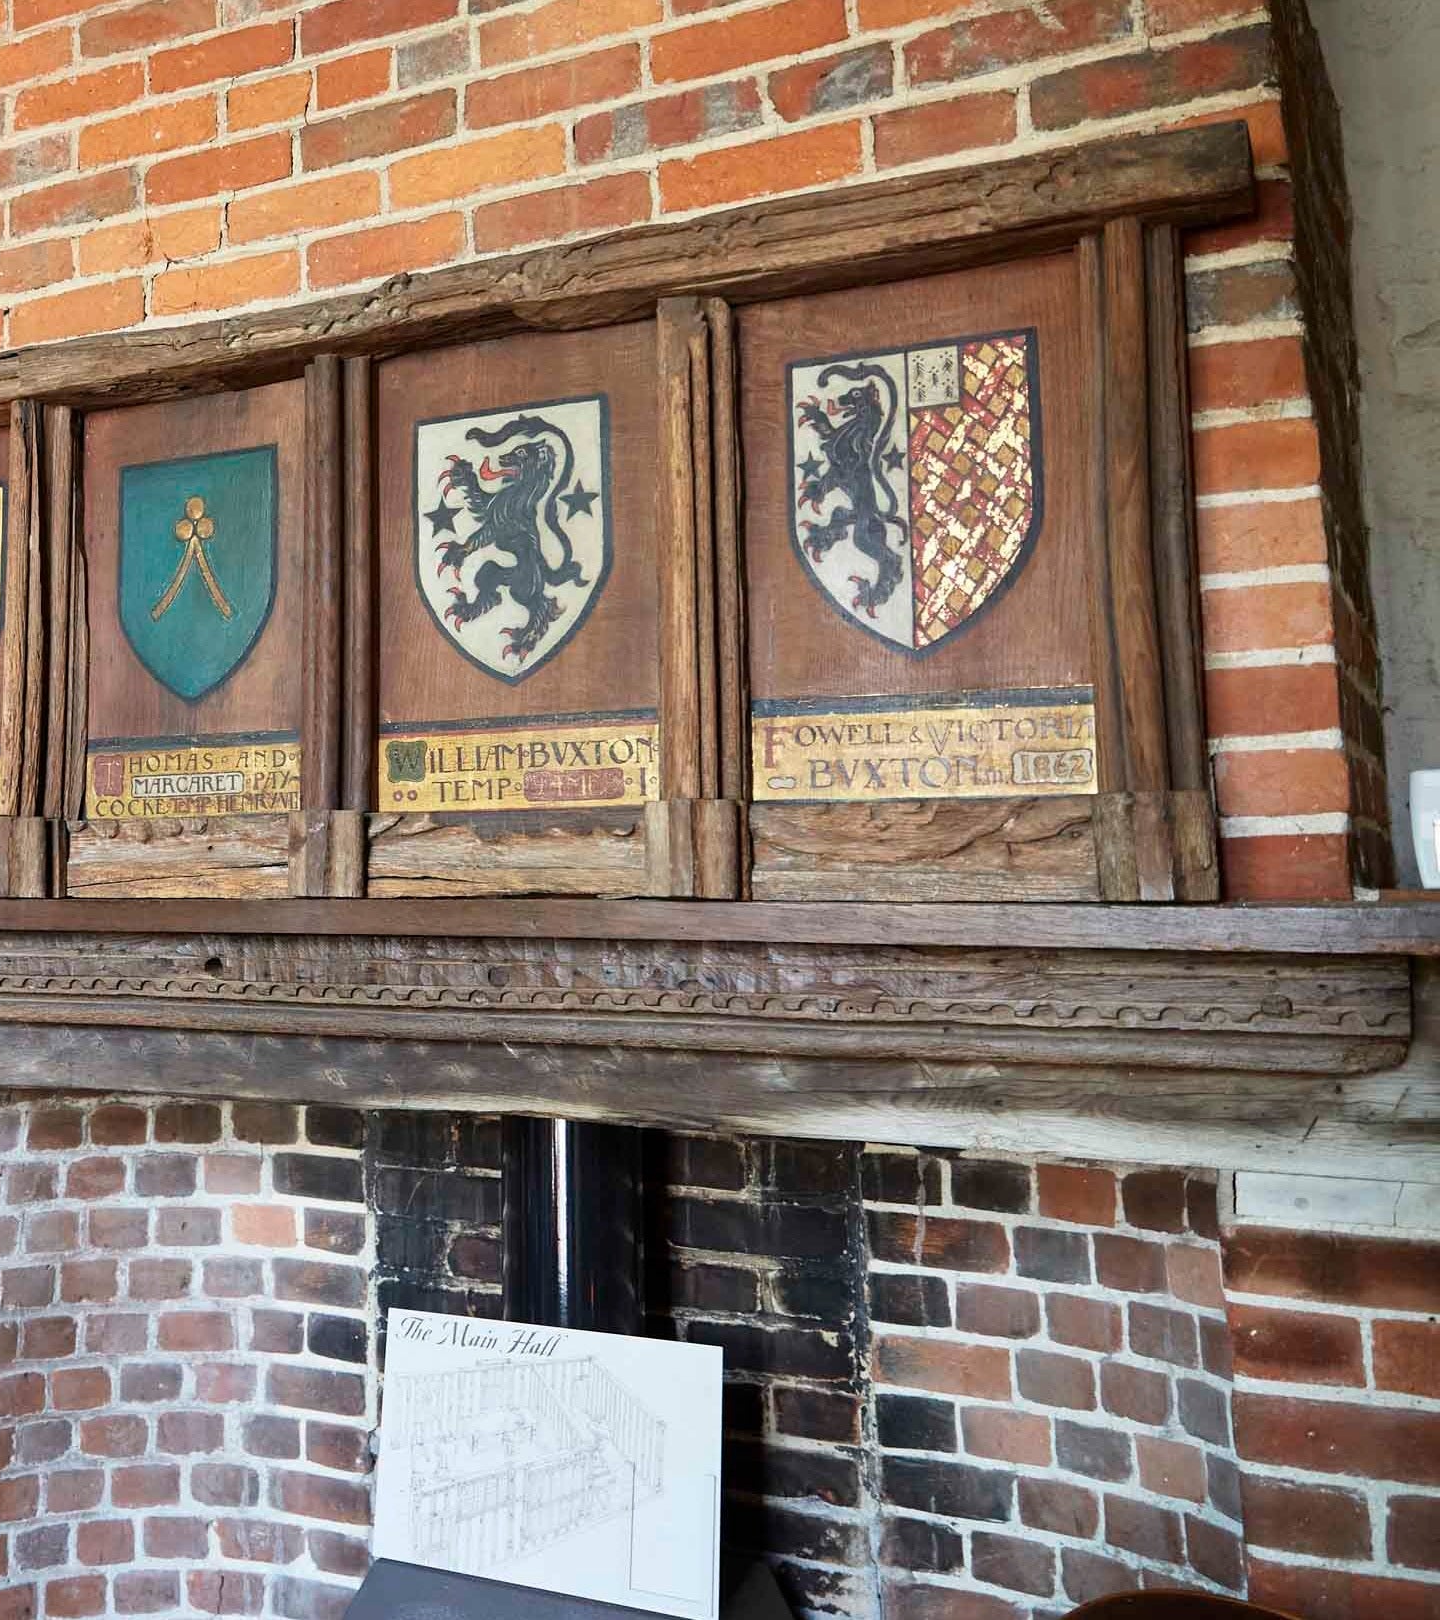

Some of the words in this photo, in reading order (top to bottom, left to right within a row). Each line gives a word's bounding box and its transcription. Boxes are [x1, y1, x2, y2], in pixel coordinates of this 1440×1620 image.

[910, 724, 922, 744] &
[235, 749, 286, 768] AND
[1019, 752, 1090, 780] 1862
[432, 778, 511, 802] TEMP
[95, 797, 169, 817] COCKE
[395, 1316, 433, 1342] The
[437, 1321, 498, 1348] Main
[499, 1329, 569, 1357] Hall
